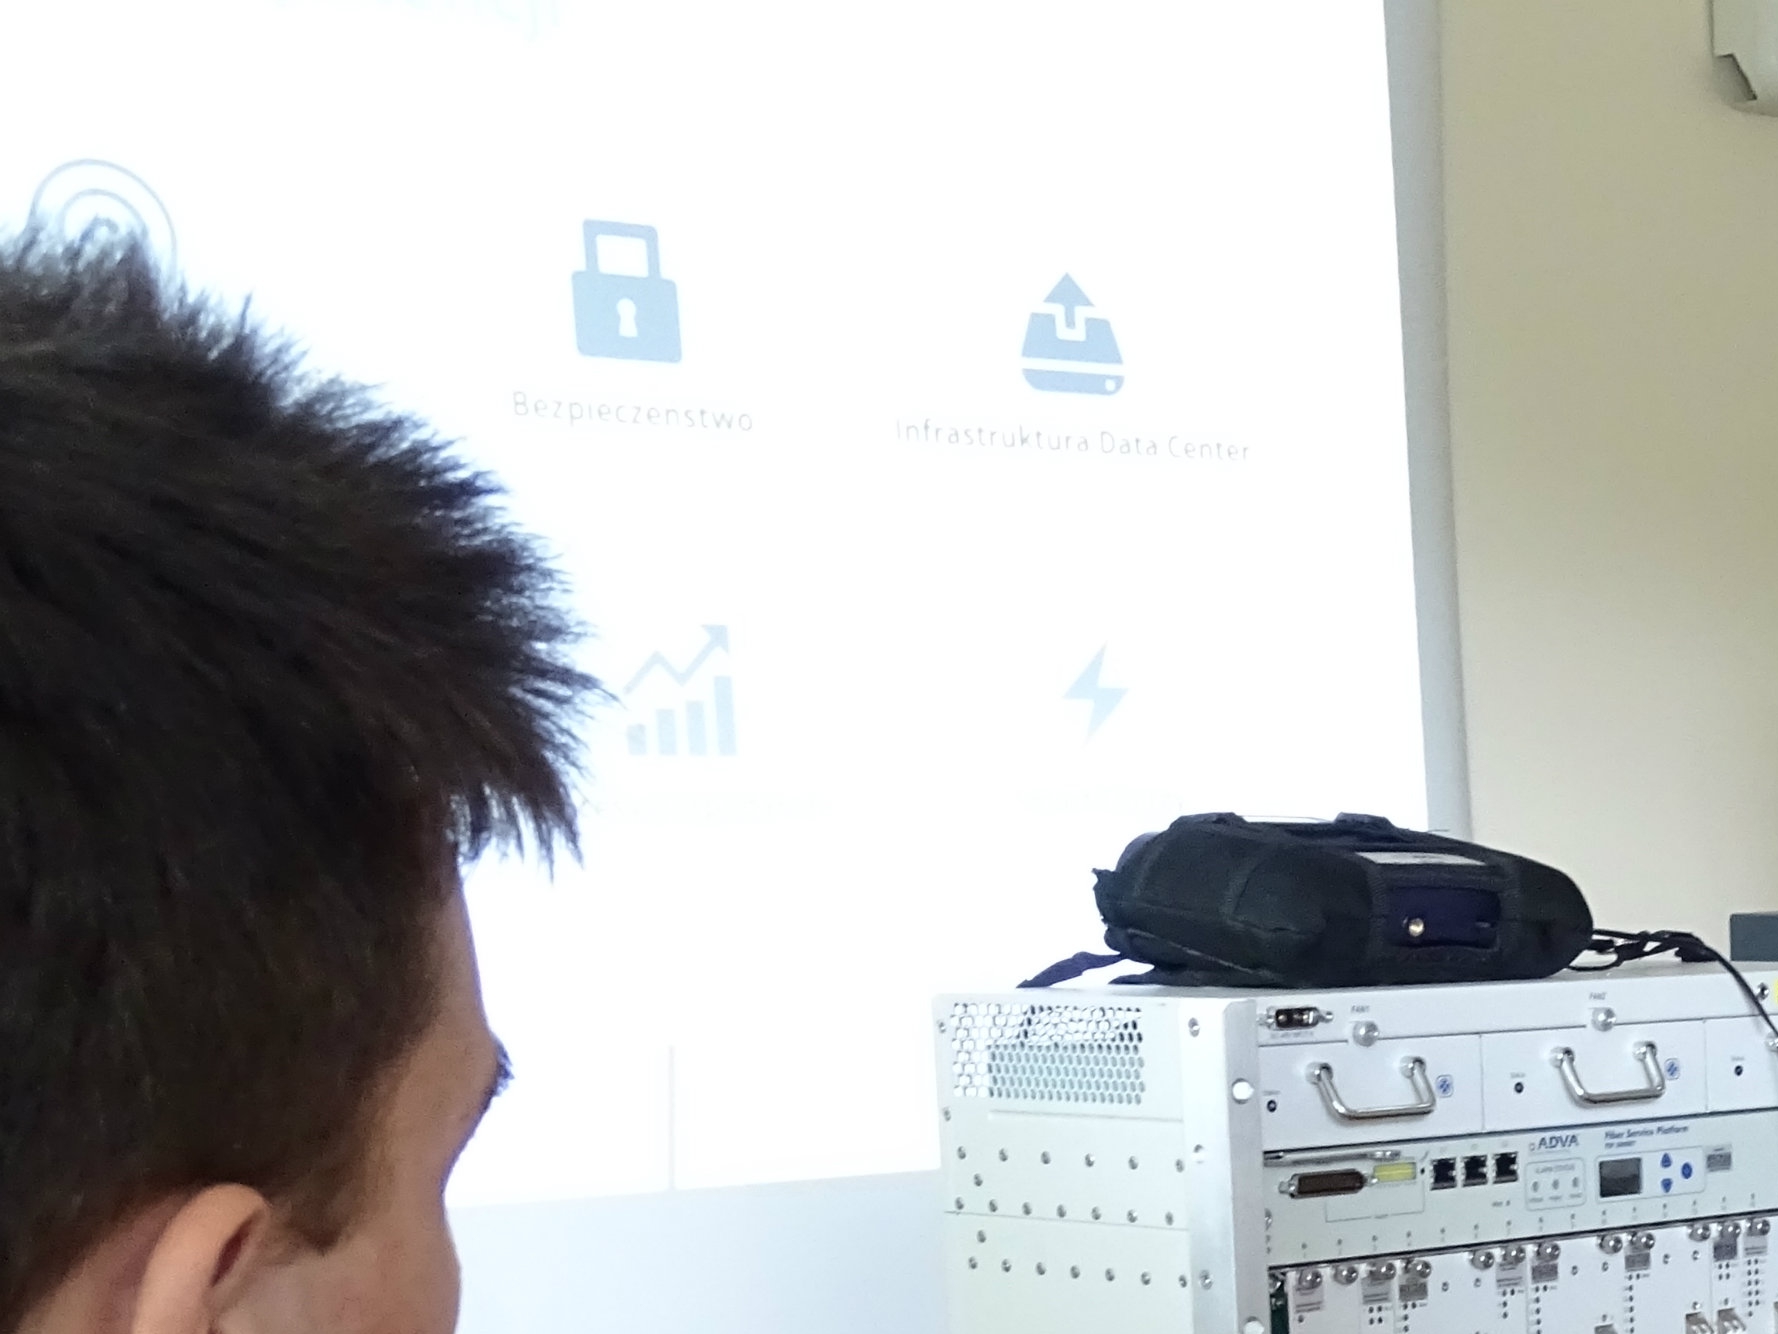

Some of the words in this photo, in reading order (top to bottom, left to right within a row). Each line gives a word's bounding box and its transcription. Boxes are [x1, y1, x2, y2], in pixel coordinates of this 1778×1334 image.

[896, 417, 1090, 452] Infrastruktura
[1099, 430, 1159, 457] Data
[1168, 434, 1249, 461] Center
[1537, 1134, 1579, 1151] ADVA
